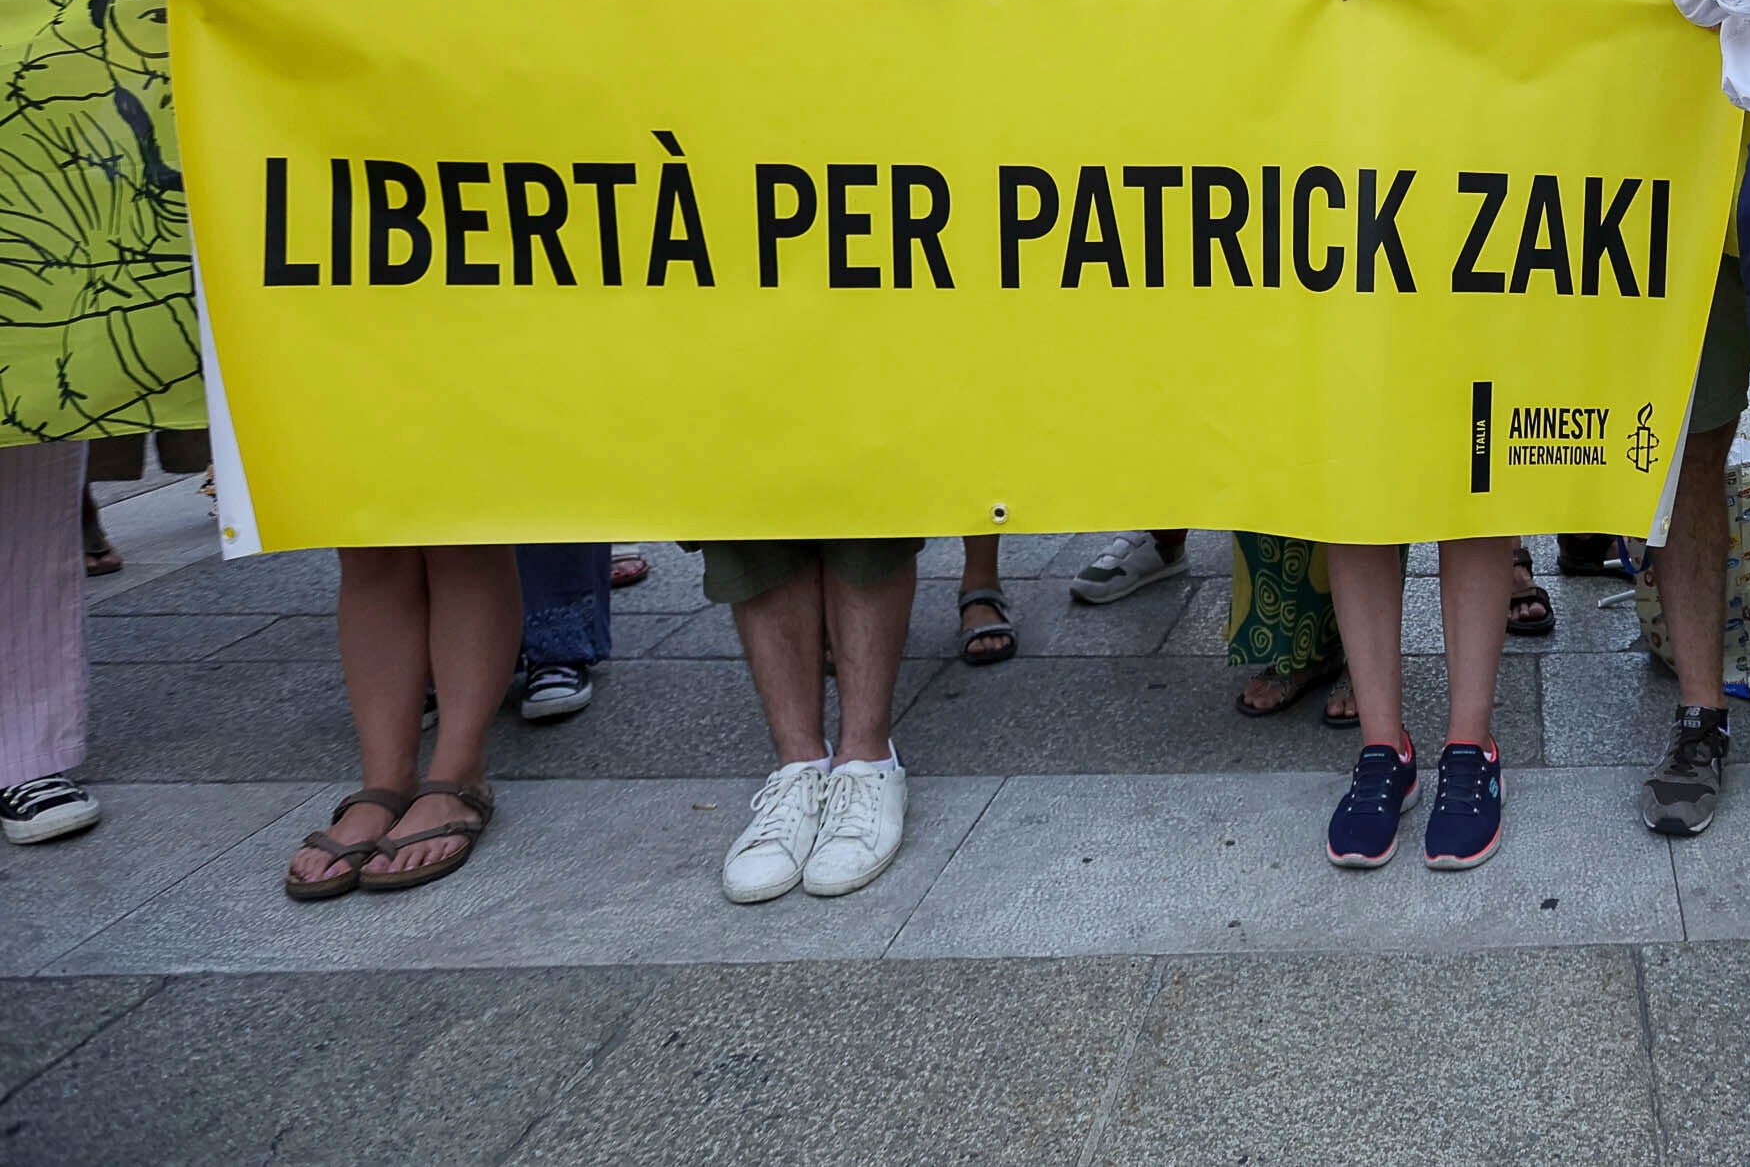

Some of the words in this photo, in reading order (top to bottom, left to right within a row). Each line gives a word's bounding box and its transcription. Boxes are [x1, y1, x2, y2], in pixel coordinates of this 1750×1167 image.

[264, 131, 715, 287] LIBERTÀ
[756, 164, 955, 288] PER
[999, 166, 1416, 292] PATRICK
[1452, 172, 1670, 298] ZAKI
[1476, 420, 1486, 455] ITALIA
[1509, 408, 1609, 439] AMNESTY
[1509, 446, 1606, 465] INTERNATIONAL
